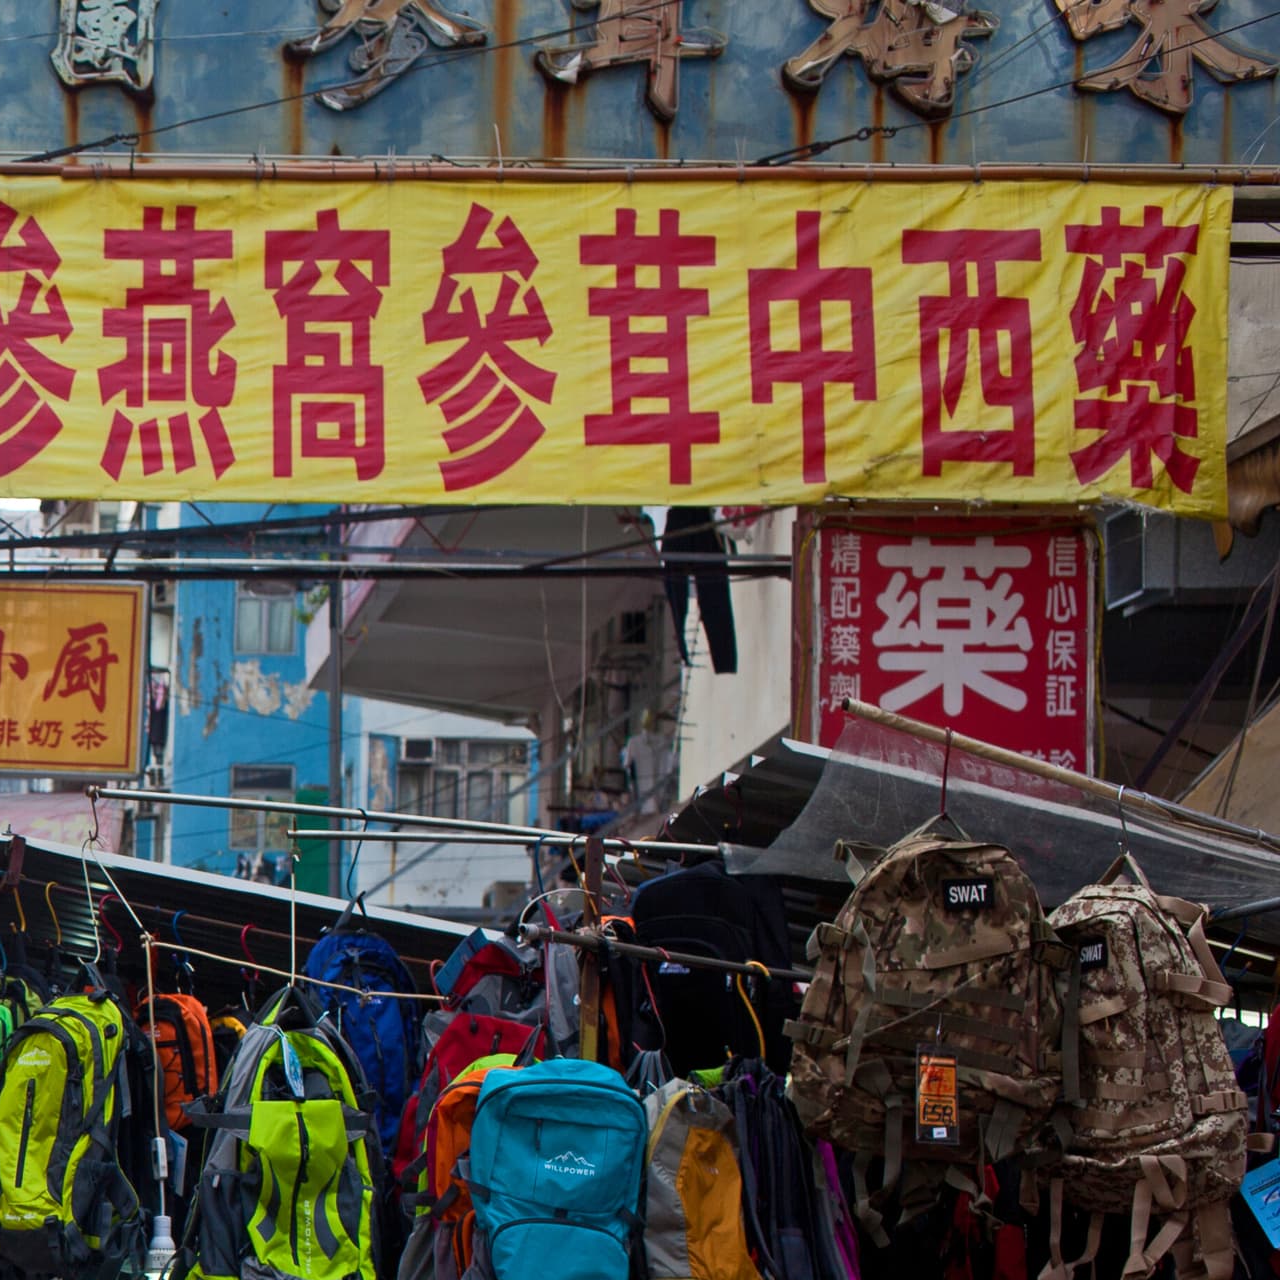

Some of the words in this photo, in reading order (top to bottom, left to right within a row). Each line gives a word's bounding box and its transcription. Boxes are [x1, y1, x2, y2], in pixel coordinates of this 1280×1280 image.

[871, 536, 1034, 717] 藥
[948, 884, 988, 905] SWAT
[1079, 942, 1104, 964] SWAT
[543, 1163, 595, 1177] WILLPOWER
